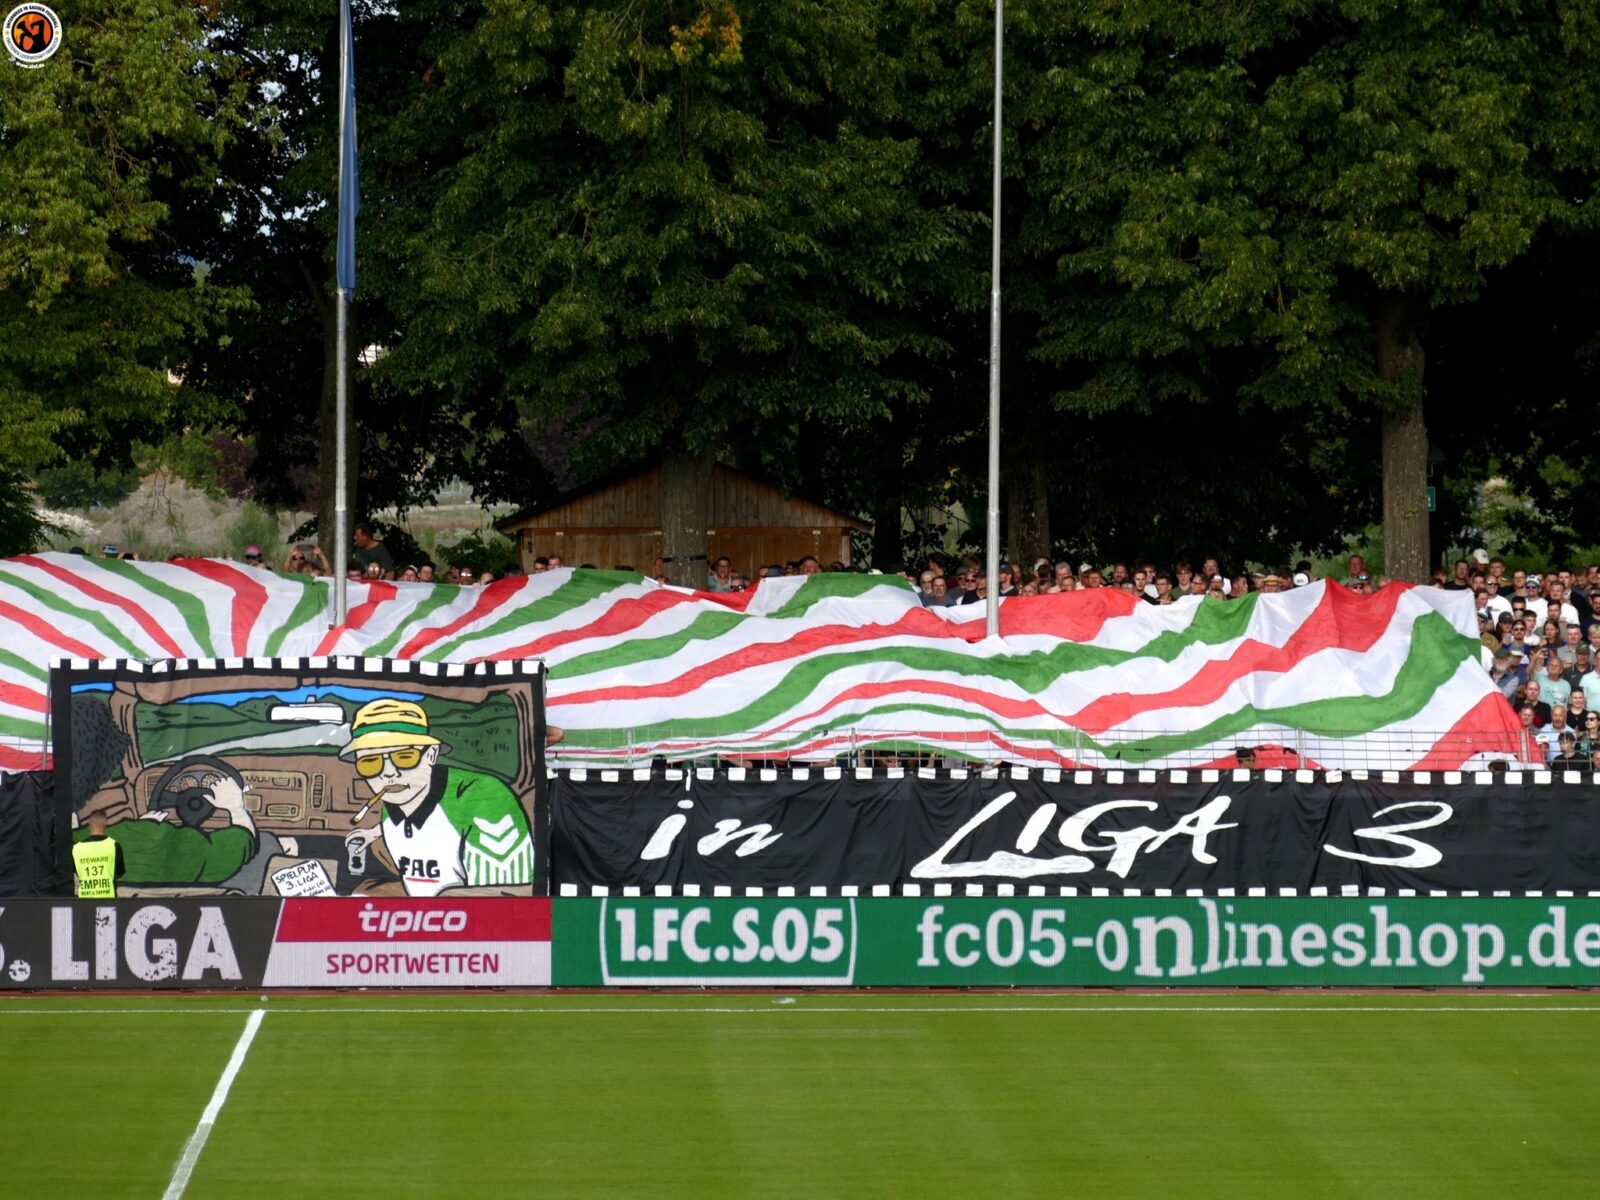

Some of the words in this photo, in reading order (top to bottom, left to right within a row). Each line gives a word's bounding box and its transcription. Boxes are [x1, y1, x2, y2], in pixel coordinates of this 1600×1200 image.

[640, 800, 784, 860] in
[910, 791, 1238, 878] LIGA
[1324, 801, 1453, 868] 3
[80, 856, 109, 864] STEWARD
[84, 865, 105, 877] 137
[398, 856, 440, 878] FAG
[297, 872, 319, 887] LIGA
[358, 903, 467, 938] tipico
[51, 905, 242, 981] LIGA
[615, 907, 844, 963] 1.FC.S.05
[917, 898, 1600, 982] fc05-onlineshop.de
[326, 953, 499, 974] SPORTWETTEN
